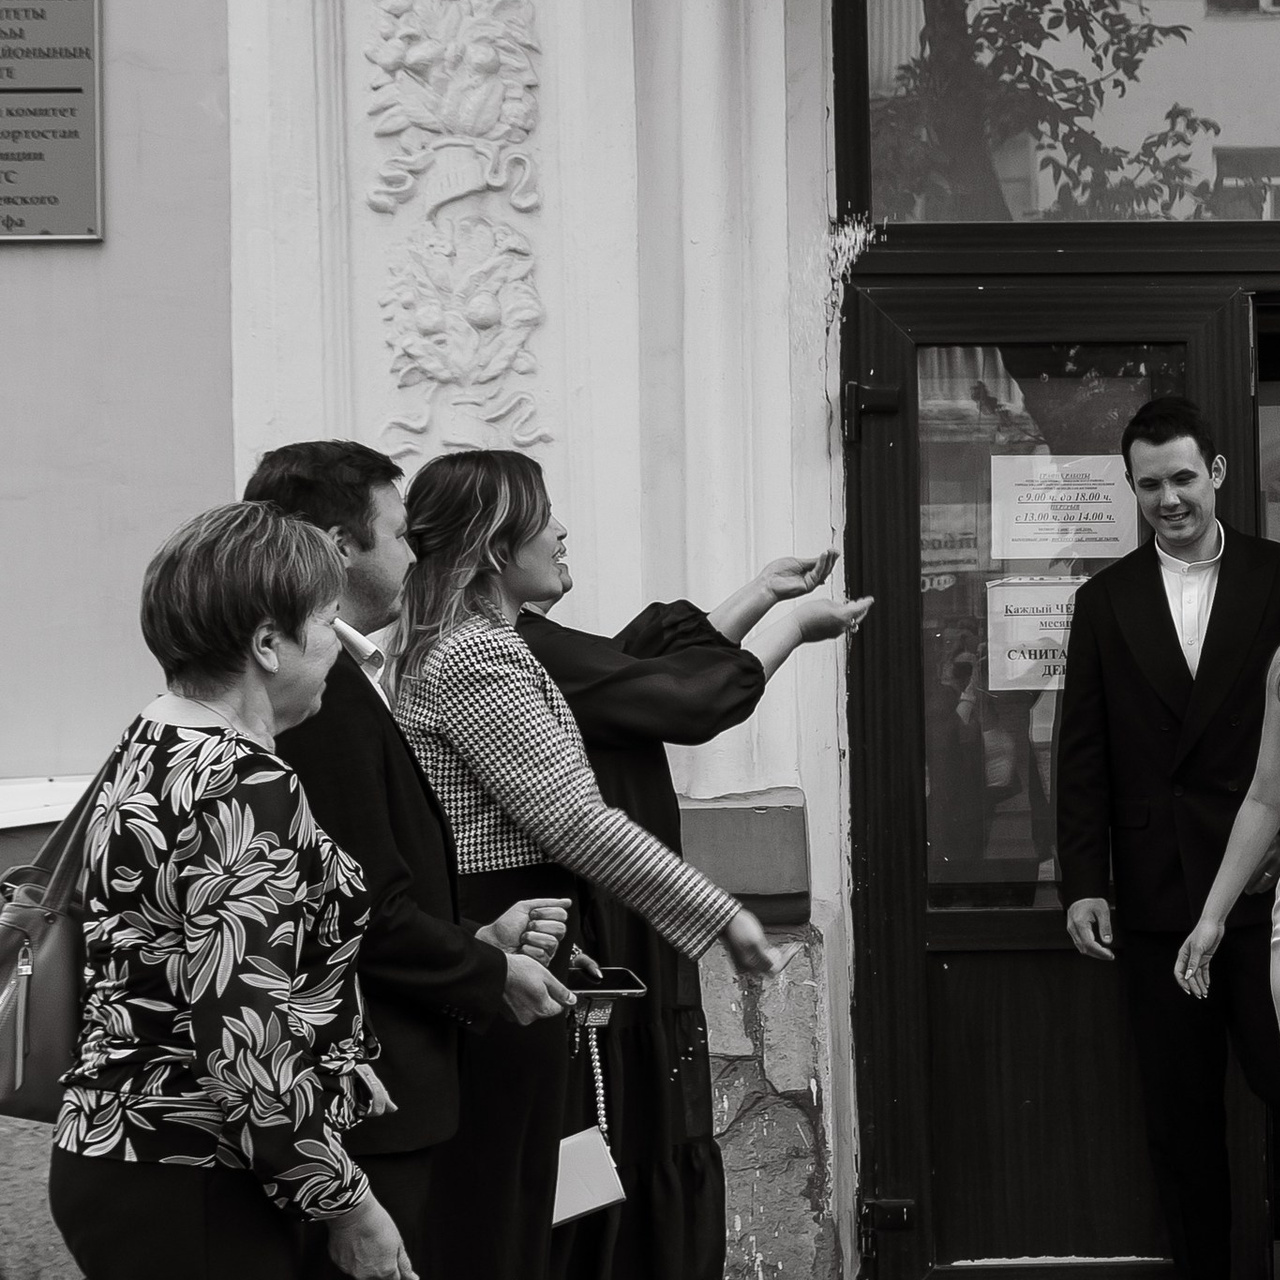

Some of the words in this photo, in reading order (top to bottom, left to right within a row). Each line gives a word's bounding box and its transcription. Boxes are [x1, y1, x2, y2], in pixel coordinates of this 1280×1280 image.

[6, 107, 78, 118] комитет
[0, 196, 60, 206] вского
[1026, 493, 1046, 501] 9.00
[1060, 493, 1071, 501] до
[1075, 493, 1100, 501] 18.00
[1024, 513, 1049, 521] 13.00
[1063, 513, 1075, 521] до
[1078, 512, 1103, 521] 14.00
[1005, 604, 1052, 614] Каждый
[1056, 603, 1075, 613] ЧЕ
